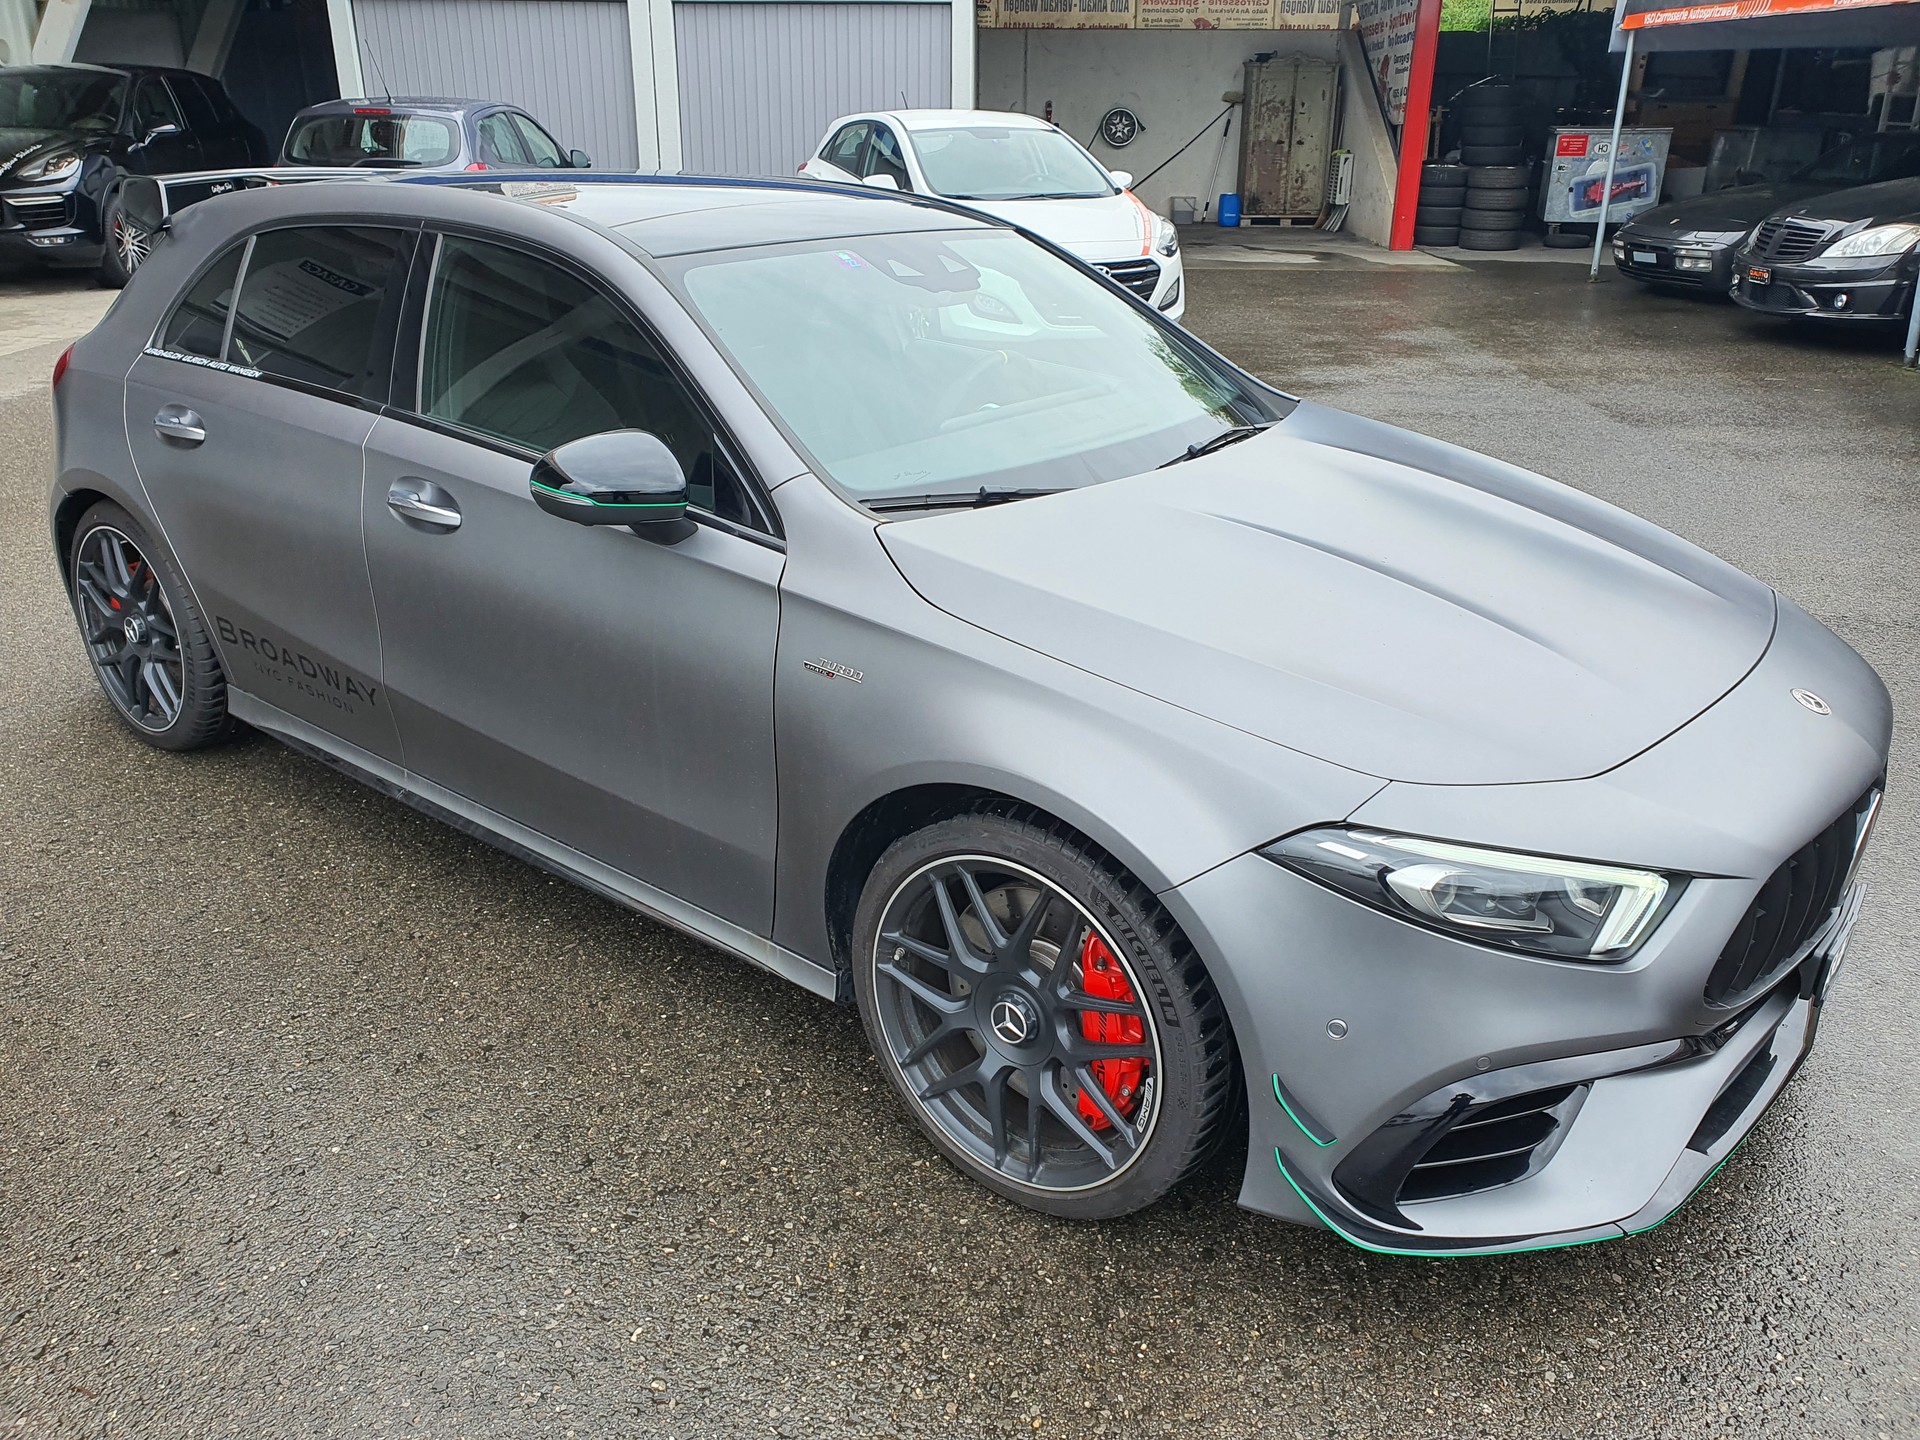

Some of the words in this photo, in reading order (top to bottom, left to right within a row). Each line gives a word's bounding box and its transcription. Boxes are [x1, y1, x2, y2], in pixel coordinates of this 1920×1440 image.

[1655, 9, 1688, 23] Carrosserie
[1688, 5, 1738, 20] Autospritzwerk
[207, 360, 230, 372] AUTO
[227, 364, 264, 378] WANGEN
[215, 614, 377, 707] BROADWAY
[819, 657, 865, 682] TURBO
[254, 662, 283, 682] NYC
[287, 676, 355, 715] FASHION
[1110, 913, 1180, 1025] MICHELIN
